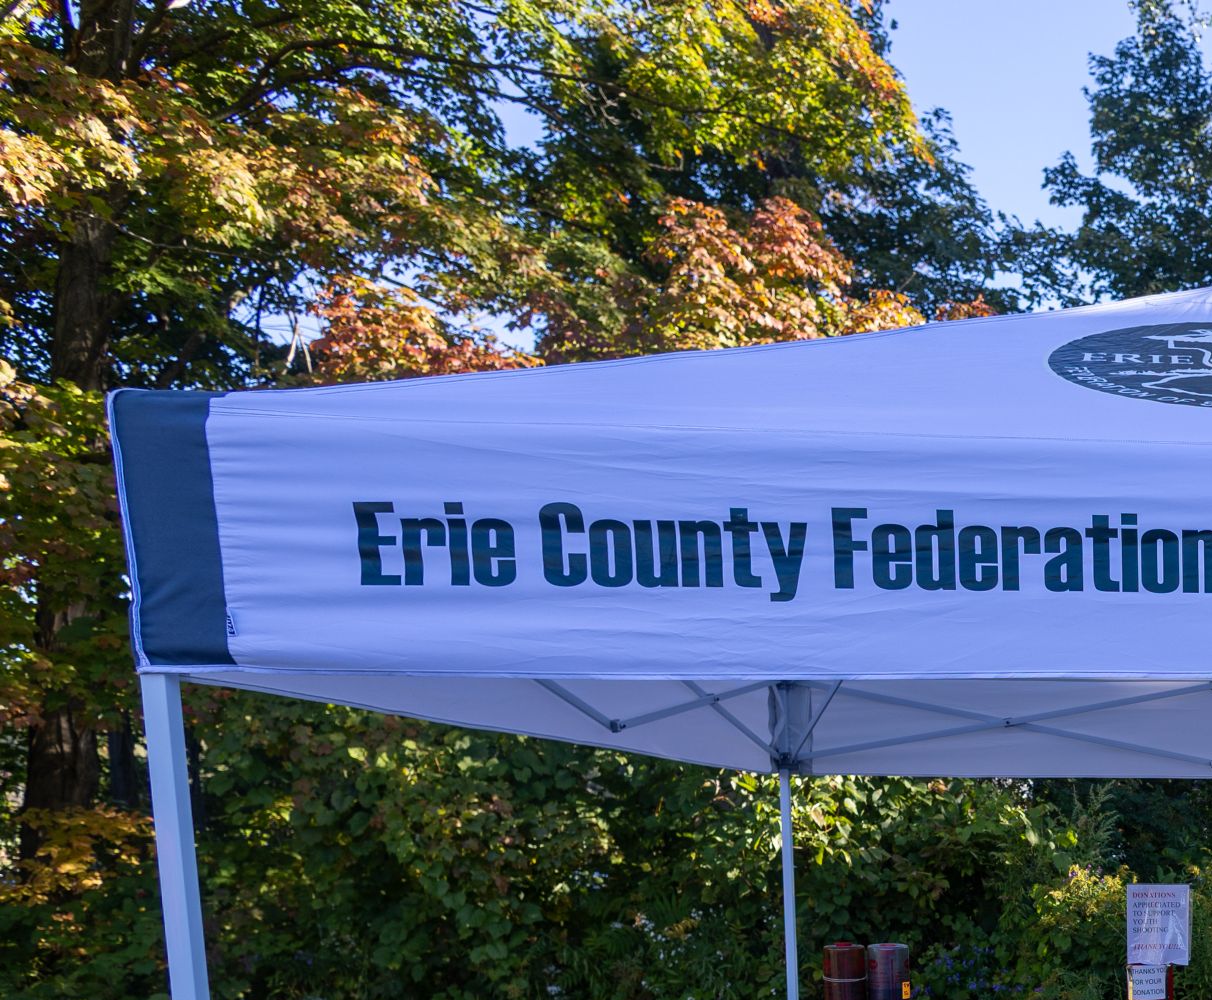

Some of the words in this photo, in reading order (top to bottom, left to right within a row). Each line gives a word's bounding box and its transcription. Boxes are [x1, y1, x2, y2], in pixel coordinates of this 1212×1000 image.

[1081, 352, 1194, 365] ERIE
[1158, 396, 1197, 404] OF
[352, 500, 517, 587] Erie
[537, 501, 808, 602] County
[1132, 891, 1176, 899] DONATIONS
[1133, 901, 1181, 909] APPRECIATED
[1132, 926, 1169, 934] SHOOTING
[1132, 967, 1156, 975] THANKS
[1132, 988, 1165, 996] DONATION
